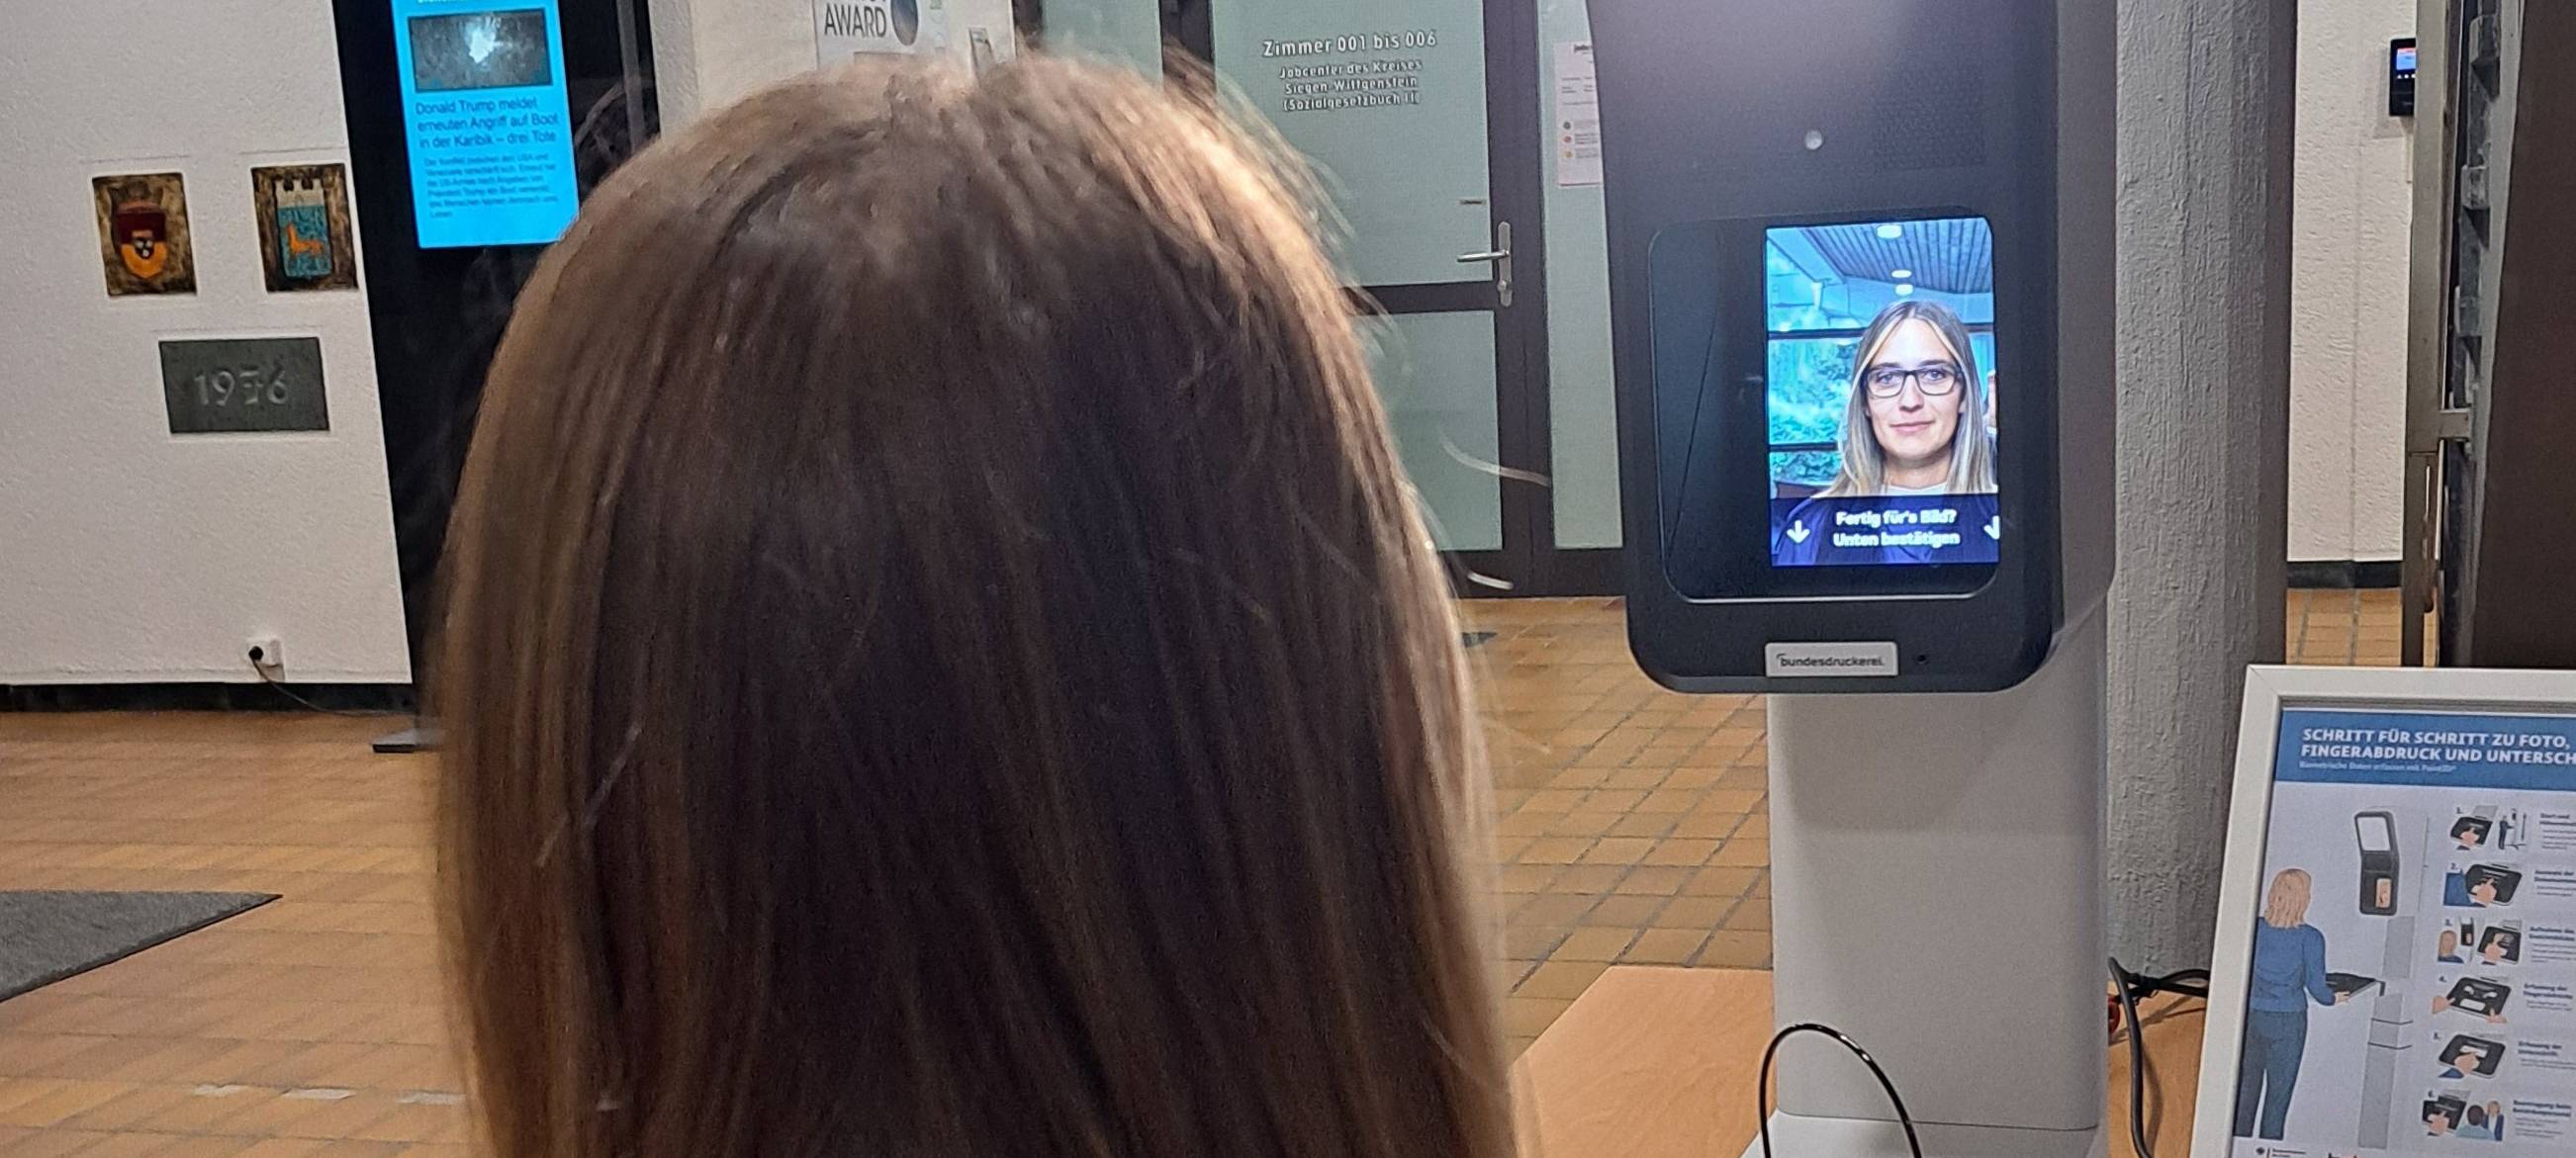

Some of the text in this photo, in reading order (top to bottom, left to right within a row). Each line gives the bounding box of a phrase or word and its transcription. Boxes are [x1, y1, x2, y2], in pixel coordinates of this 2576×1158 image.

[824, 3, 887, 38] AWARD
[1263, 30, 1437, 57] Zimmer 001 bis 006
[1279, 59, 1423, 80] Jobcenter des Kreises
[415, 97, 537, 115] Donald Trump meldet
[417, 113, 558, 132] erneuten Angriff auf Boot
[419, 136, 430, 148] in
[432, 134, 451, 147] der
[454, 132, 493, 147] Karibik
[506, 132, 528, 144] drei
[532, 130, 556, 142] Tote
[194, 369, 289, 406] 1976
[1835, 511, 1882, 528] Fertig
[1920, 508, 1958, 524] Bild?
[1833, 530, 1961, 549] Unten bestätigen
[2303, 728, 2571, 751] SCHRITT FÜR SCHRITT ZU FOTO,
[2301, 745, 2576, 765] FINGERABDRUCK UND UNTERSCH
